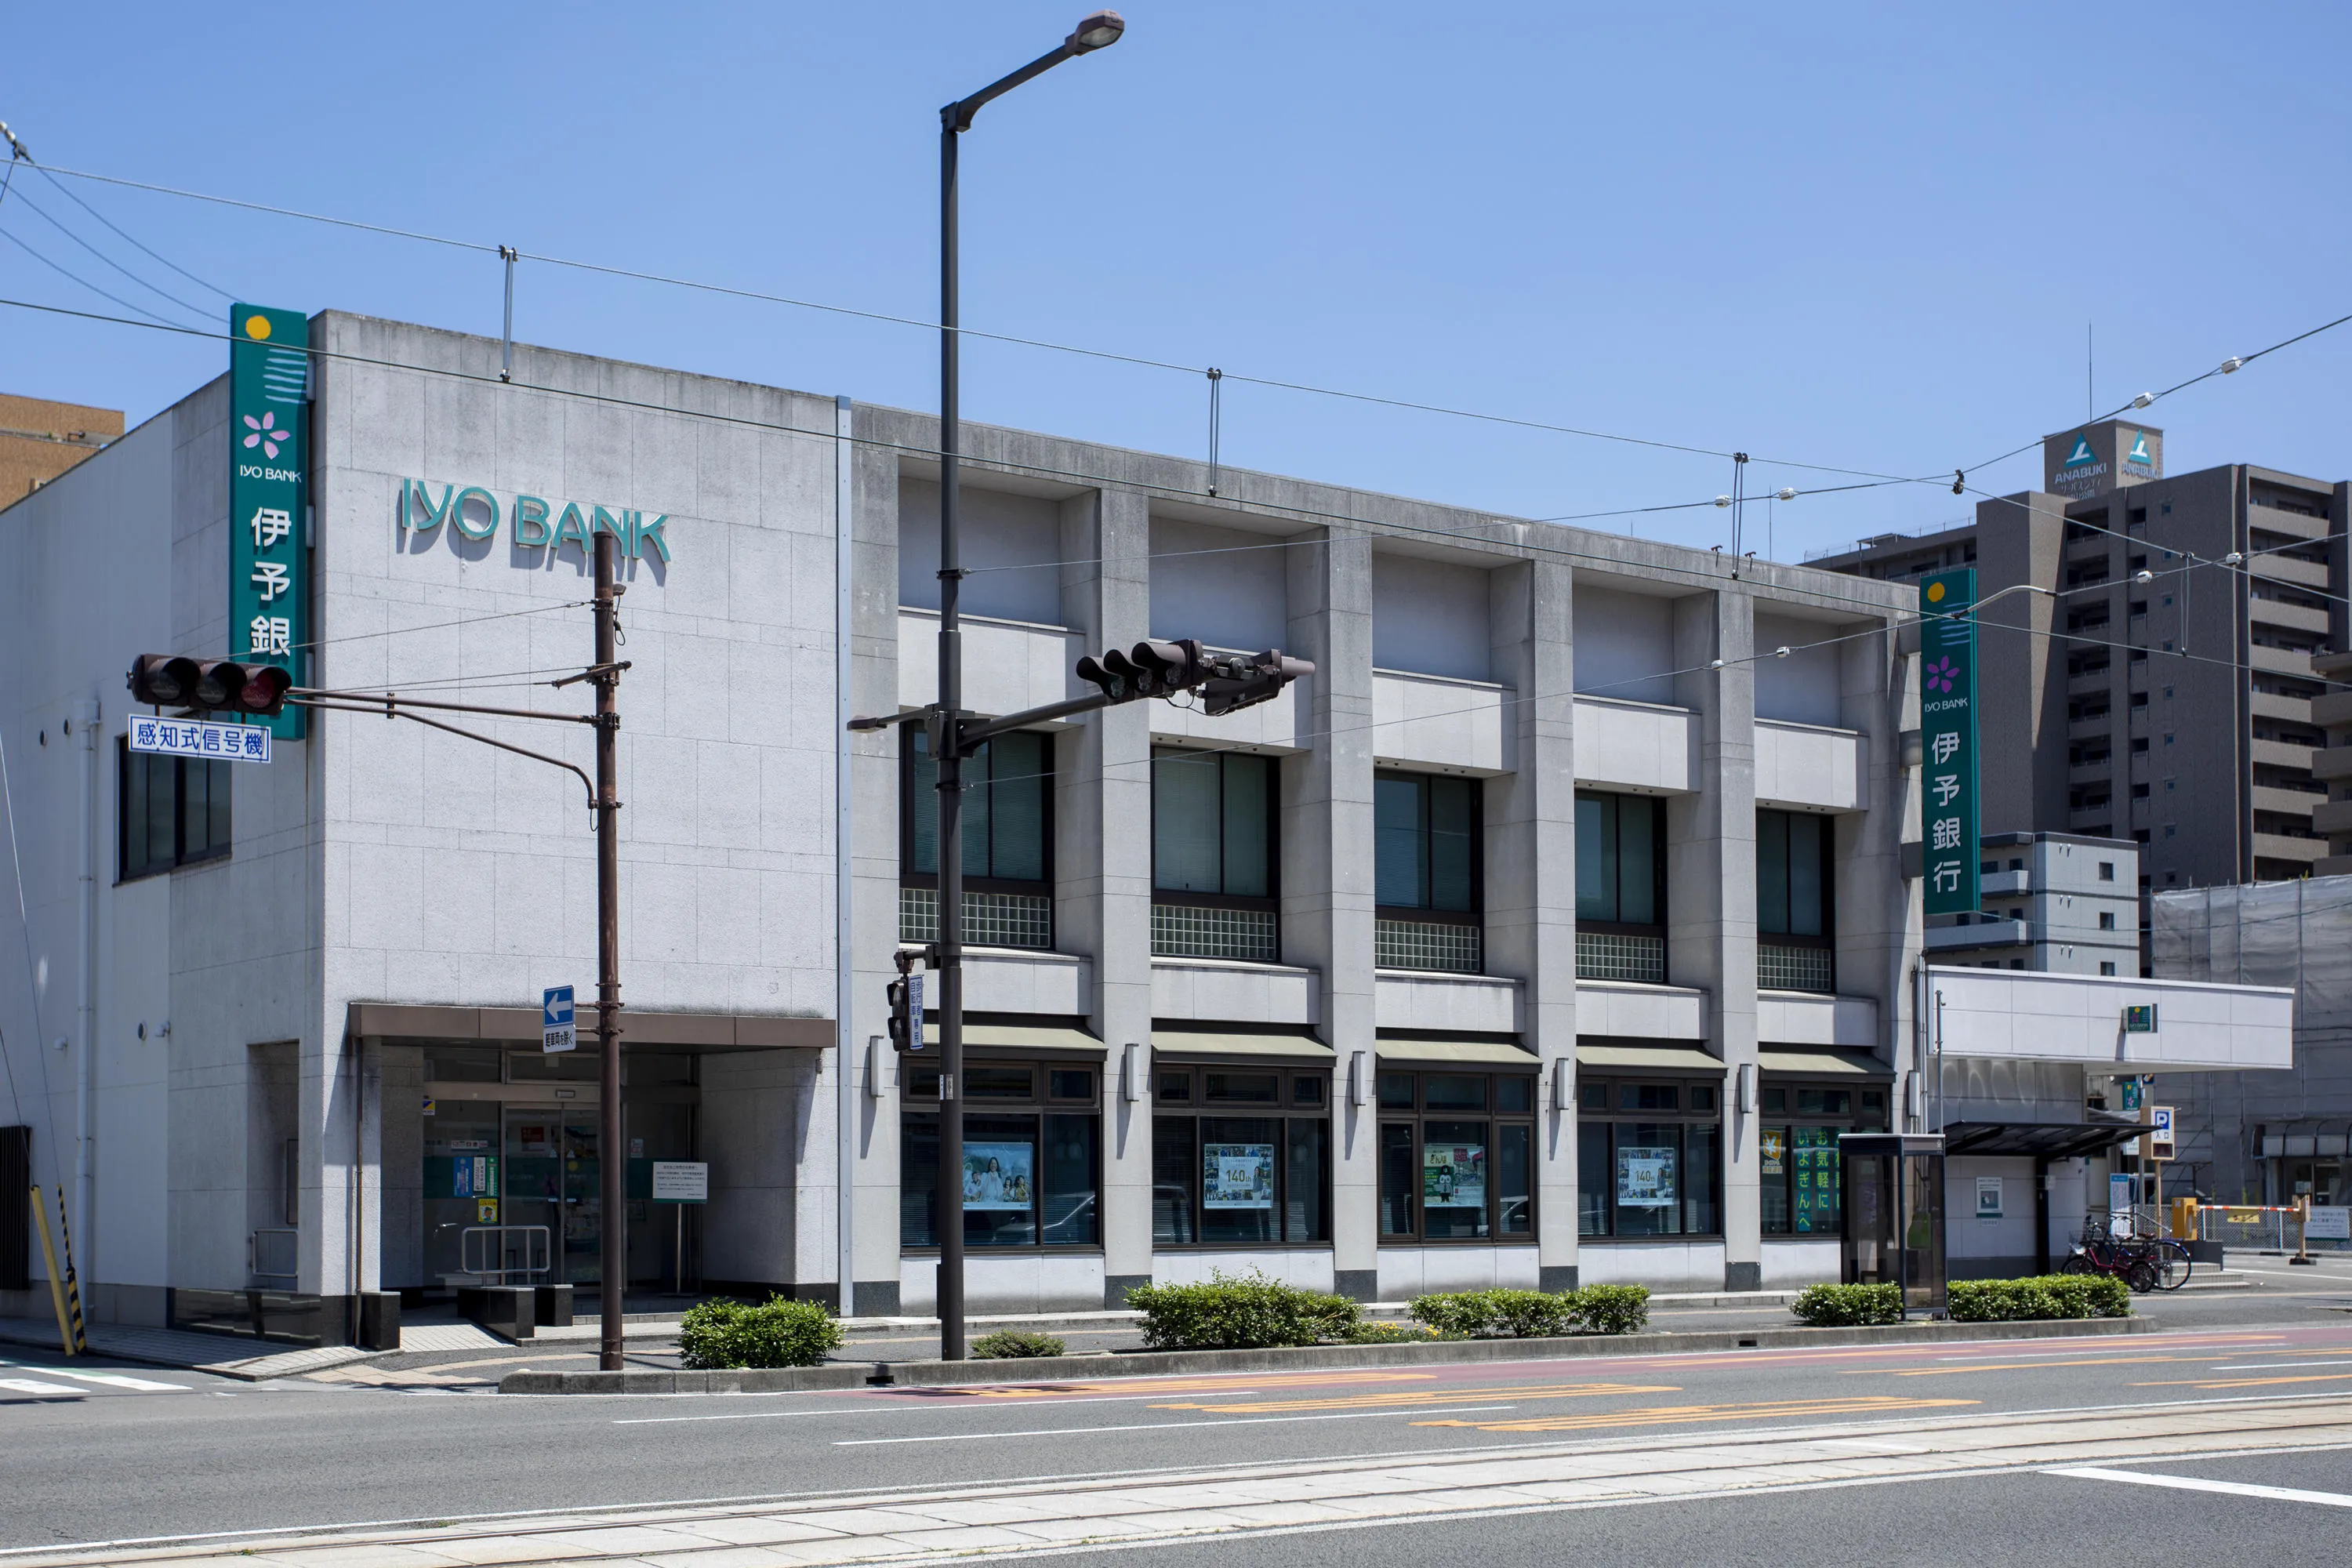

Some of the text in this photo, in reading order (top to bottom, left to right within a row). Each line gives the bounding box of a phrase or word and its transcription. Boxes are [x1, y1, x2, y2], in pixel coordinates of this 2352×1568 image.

[240, 465, 302, 483] IYO BANK
[2055, 463, 2107, 484] ANABUKI
[402, 477, 671, 562] IYO BANK
[251, 507, 292, 657] 伊予銀
[1925, 697, 1968, 713] IYO BANK
[138, 724, 263, 756] 感知式信号機
[1932, 731, 1962, 893] 伊予銀行
[2156, 1113, 2168, 1127] P
[1798, 1131, 1811, 1227] いよぎんへ
[1817, 1131, 1829, 1209] お気軽に
